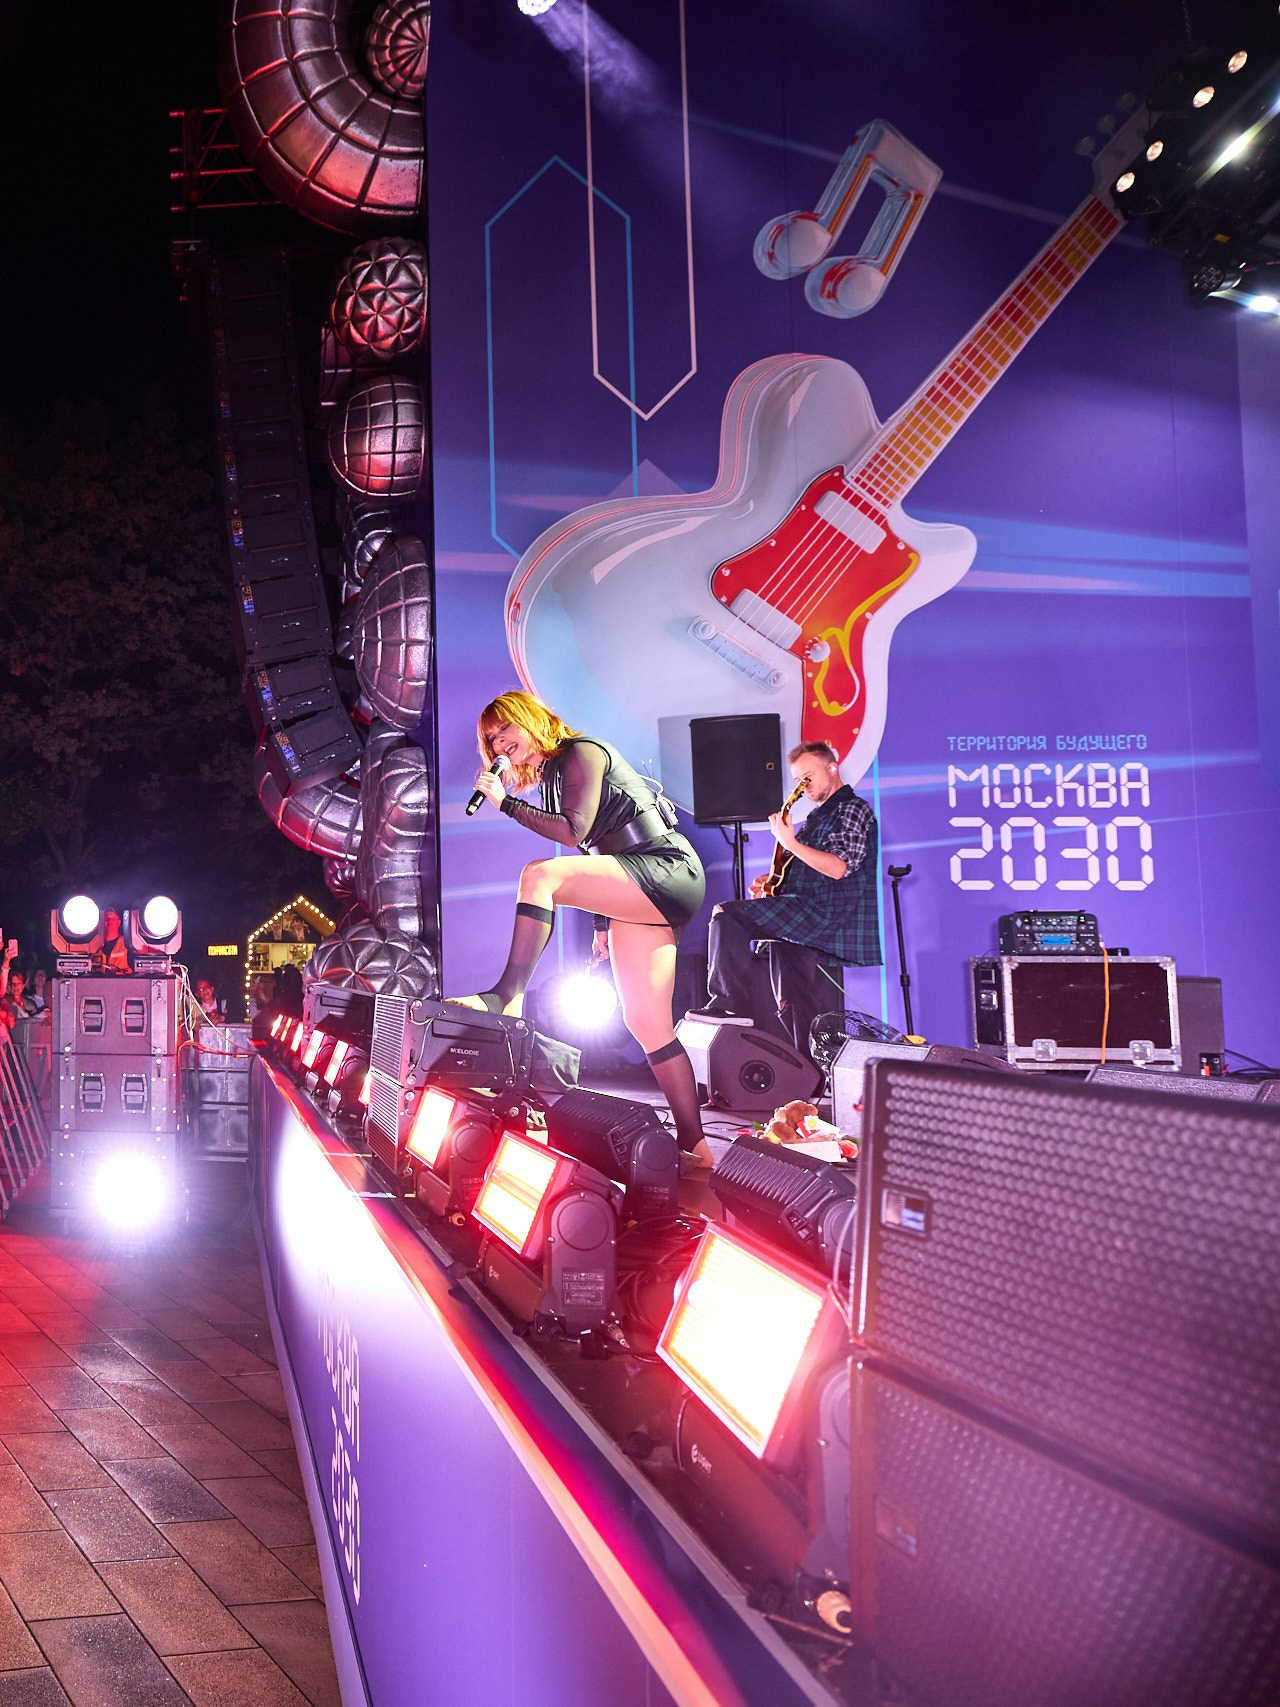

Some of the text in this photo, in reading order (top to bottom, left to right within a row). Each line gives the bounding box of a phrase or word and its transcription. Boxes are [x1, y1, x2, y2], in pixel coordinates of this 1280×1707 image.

[947, 734, 1147, 751] ТЕРРИТОРИЯ БУДУЩЕГО
[948, 762, 1150, 808] МОСКВА
[948, 816, 1154, 891] 2030
[450, 1047, 480, 1056] MELODIE
[332, 1406, 360, 1605] 2030
